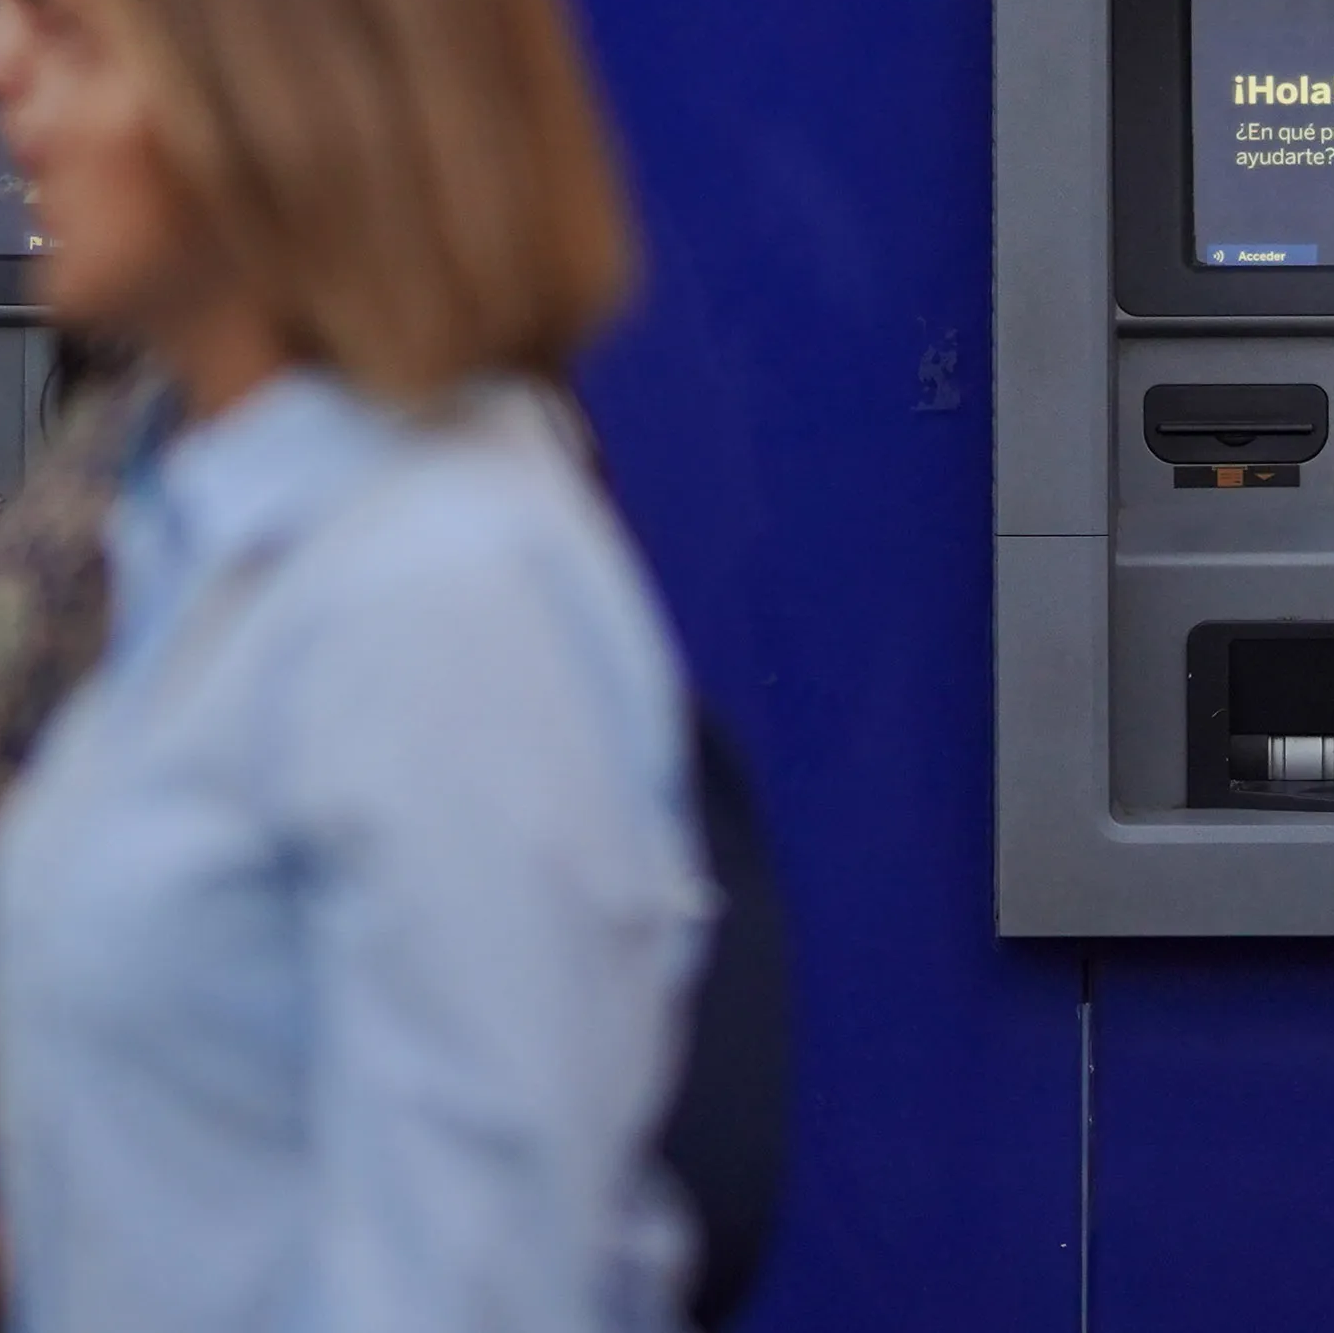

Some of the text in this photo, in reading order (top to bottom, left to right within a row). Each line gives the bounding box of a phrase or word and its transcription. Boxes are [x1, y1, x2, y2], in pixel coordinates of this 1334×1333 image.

[1235, 123, 1273, 141] ¿En
[1278, 123, 1316, 144] qué
[1238, 250, 1286, 262] Acceder
